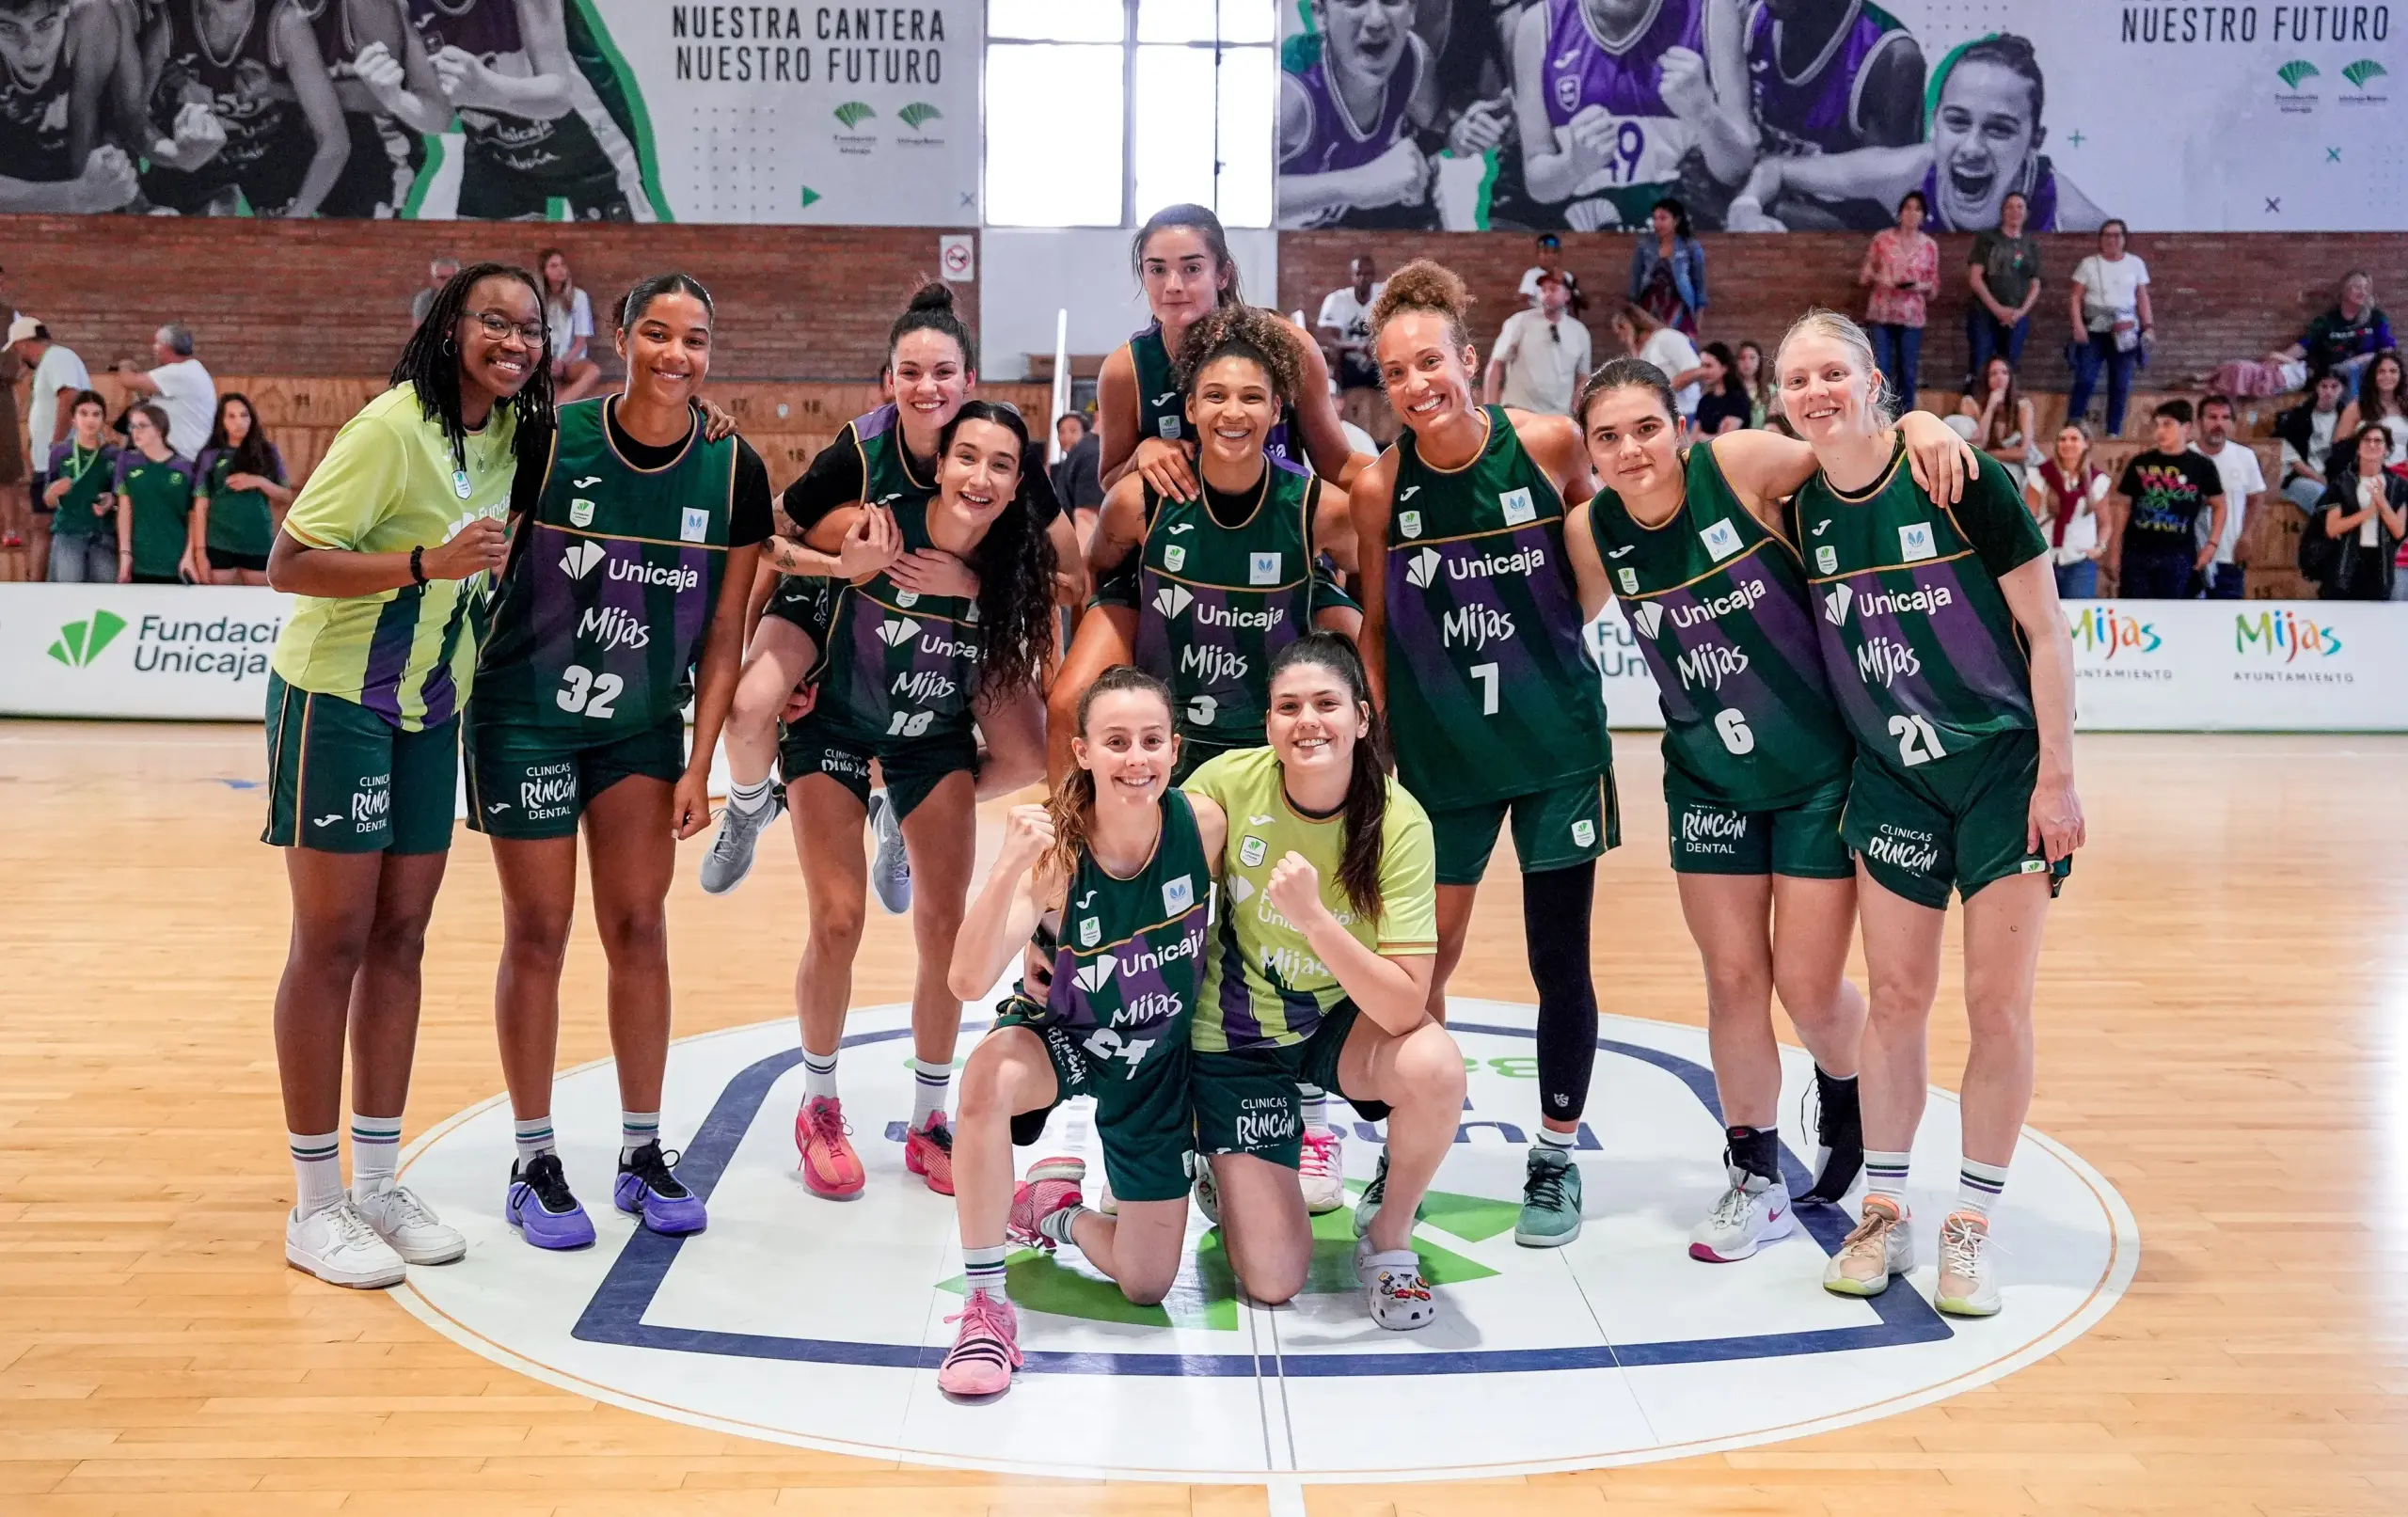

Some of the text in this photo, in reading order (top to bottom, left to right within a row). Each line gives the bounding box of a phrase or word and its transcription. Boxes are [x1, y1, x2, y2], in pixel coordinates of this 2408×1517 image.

[673, 5, 945, 41] NUESTRA CANTERA
[2121, 5, 2389, 43] NUESTRO FUTURO
[676, 45, 942, 84] NUESTRO FUTURO
[608, 558, 699, 593] Unicaja
[1448, 545, 1545, 580] Unicaja
[1196, 603, 1284, 632] Unicaja
[1671, 578, 1766, 628] Unicaja
[1859, 584, 1953, 617] Unicaja
[139, 614, 281, 643] Fundaci
[577, 607, 650, 652] Mijas
[1443, 603, 1515, 651] Mijas
[2235, 609, 2343, 665] Mijas
[135, 644, 268, 682] Unicaja
[1180, 643, 1249, 686] Mijas
[1677, 641, 1749, 691] Mijas
[1857, 636, 1921, 689] Mijas
[2233, 672, 2354, 684] AYUNTAMIENTO
[556, 664, 625, 719] 32
[891, 671, 957, 704] Mijas
[1469, 662, 1499, 716] 7
[886, 710, 934, 737] 18
[1187, 694, 1219, 726] 3
[1714, 707, 1754, 755] 6
[1888, 714, 1947, 767] 21
[359, 773, 389, 787] CLINICA
[526, 762, 571, 777] CLINICAS
[529, 805, 572, 820] DENTAL
[1686, 842, 1735, 854] DENTAL
[1879, 824, 1933, 842] CLINICAS
[1110, 991, 1183, 1029] Mijas
[1241, 1097, 1288, 1110] CLINICAS
